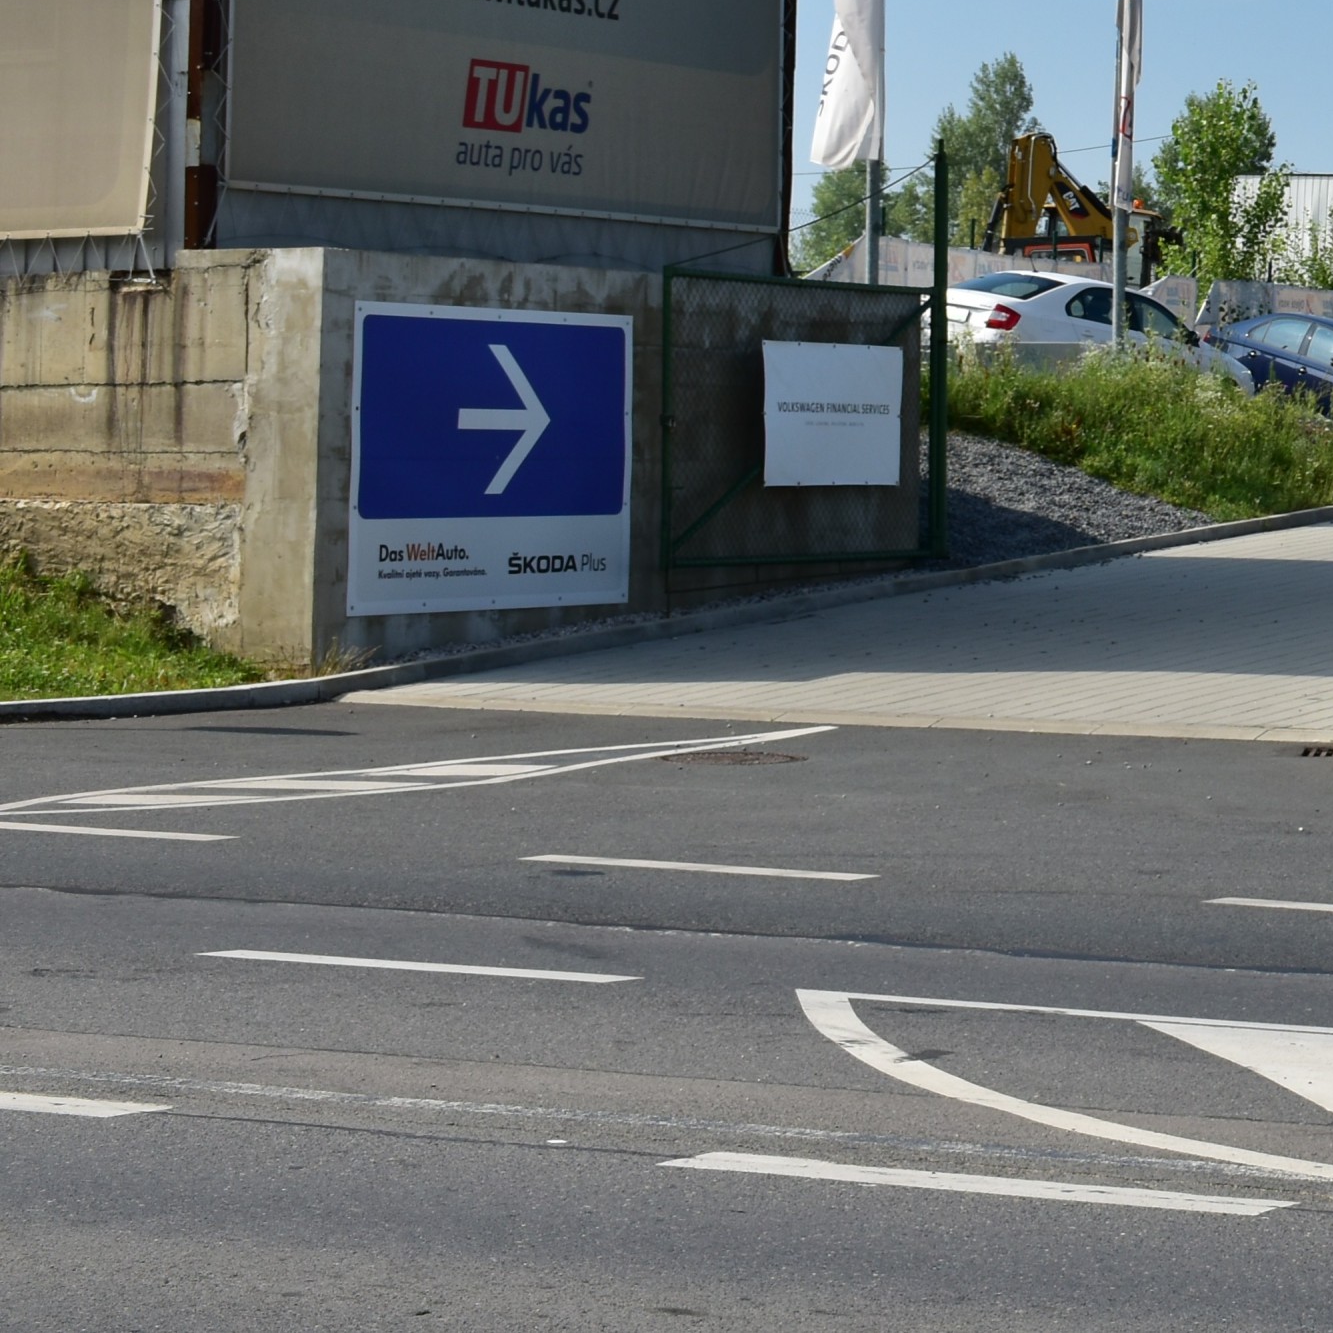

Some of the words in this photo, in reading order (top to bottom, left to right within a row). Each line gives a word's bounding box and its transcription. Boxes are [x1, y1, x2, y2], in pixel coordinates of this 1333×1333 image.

[470, 63, 592, 134] TUkas
[455, 139, 504, 168] auta
[507, 146, 543, 176] pro
[550, 144, 584, 176] vás
[1062, 191, 1080, 211] CAT
[777, 402, 825, 413] VOLKSWAGEN
[826, 403, 860, 414] FINANCIAL
[861, 404, 890, 415] SERVICES
[379, 544, 404, 562] Das
[406, 542, 469, 562] WeltAuto.
[508, 552, 577, 575] ŠKODA
[581, 553, 607, 571] Plus
